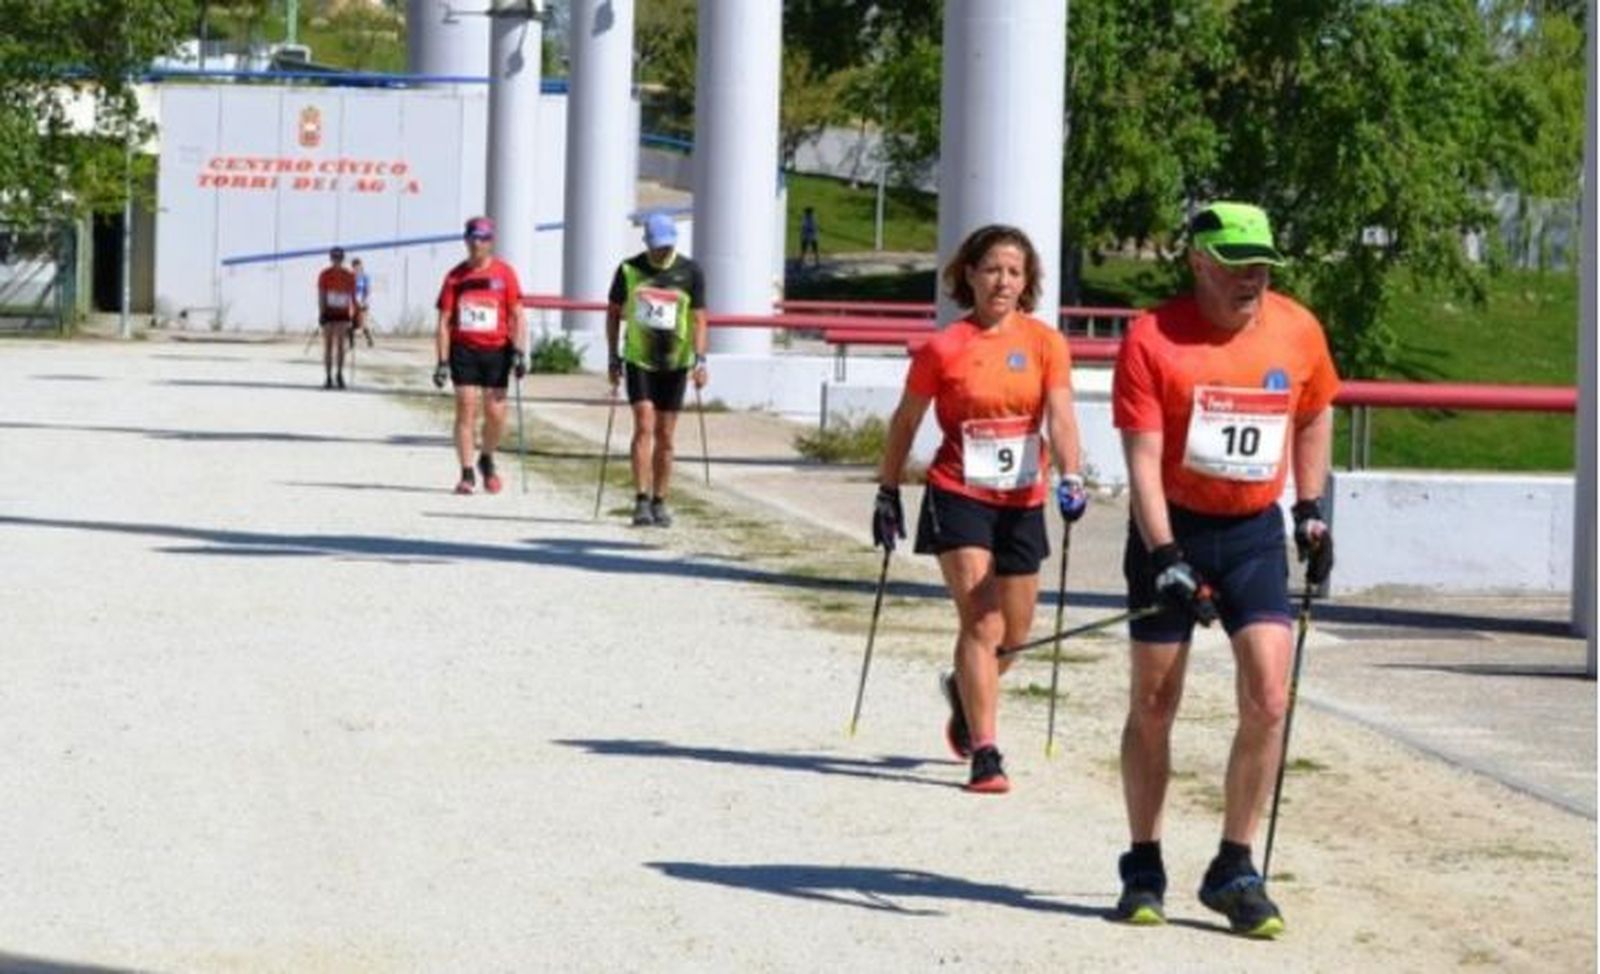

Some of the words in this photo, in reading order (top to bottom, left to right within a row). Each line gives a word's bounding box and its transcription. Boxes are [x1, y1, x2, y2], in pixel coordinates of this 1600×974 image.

[209, 157, 313, 173] CENTRO
[354, 179, 420, 194] AGA
[1221, 425, 1261, 456] 10
[998, 447, 1014, 473] 9
